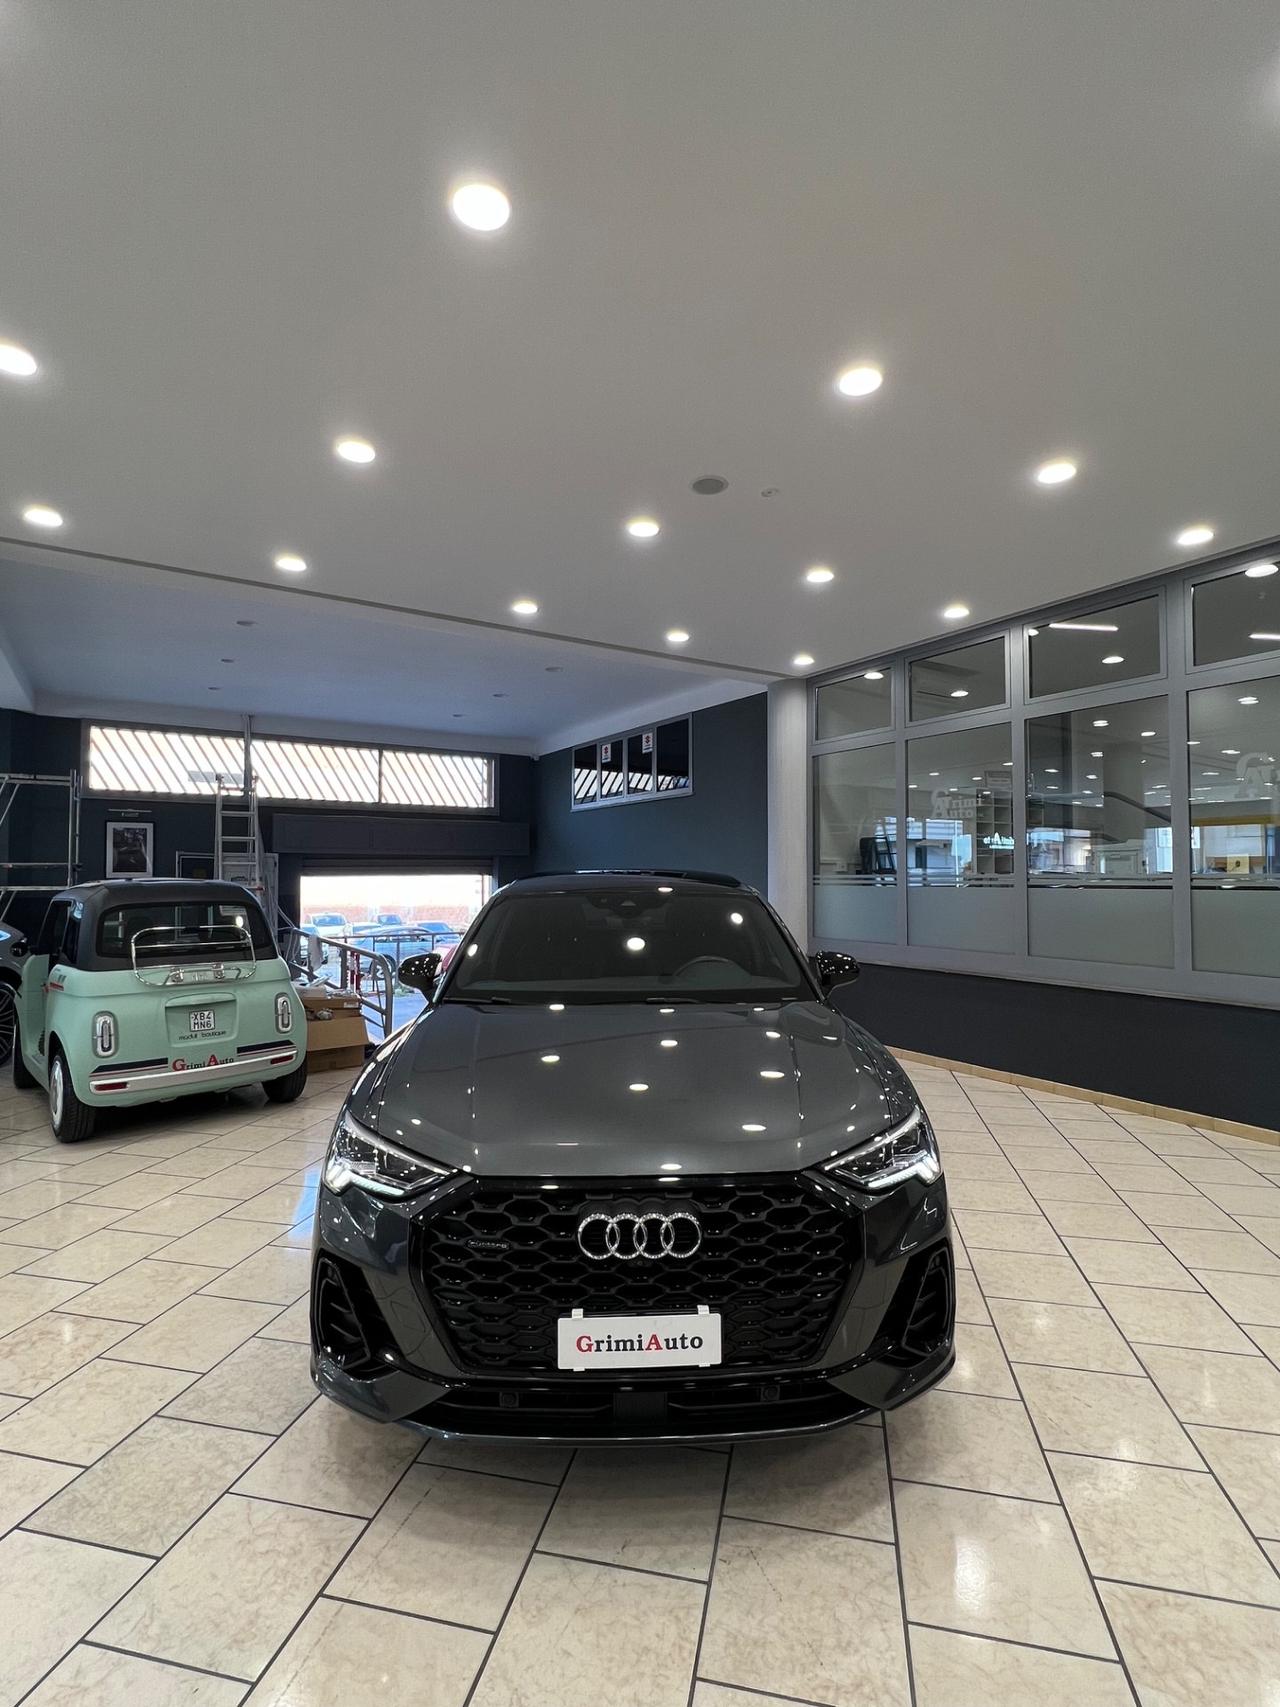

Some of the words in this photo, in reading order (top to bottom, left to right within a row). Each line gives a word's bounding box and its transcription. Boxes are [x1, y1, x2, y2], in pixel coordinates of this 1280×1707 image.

[931, 789, 984, 809] Grimi
[931, 798, 974, 818] Auto
[193, 1012, 212, 1021] XB4
[193, 1020, 212, 1030] MN6
[576, 1333, 704, 1353] GrimiAuto
